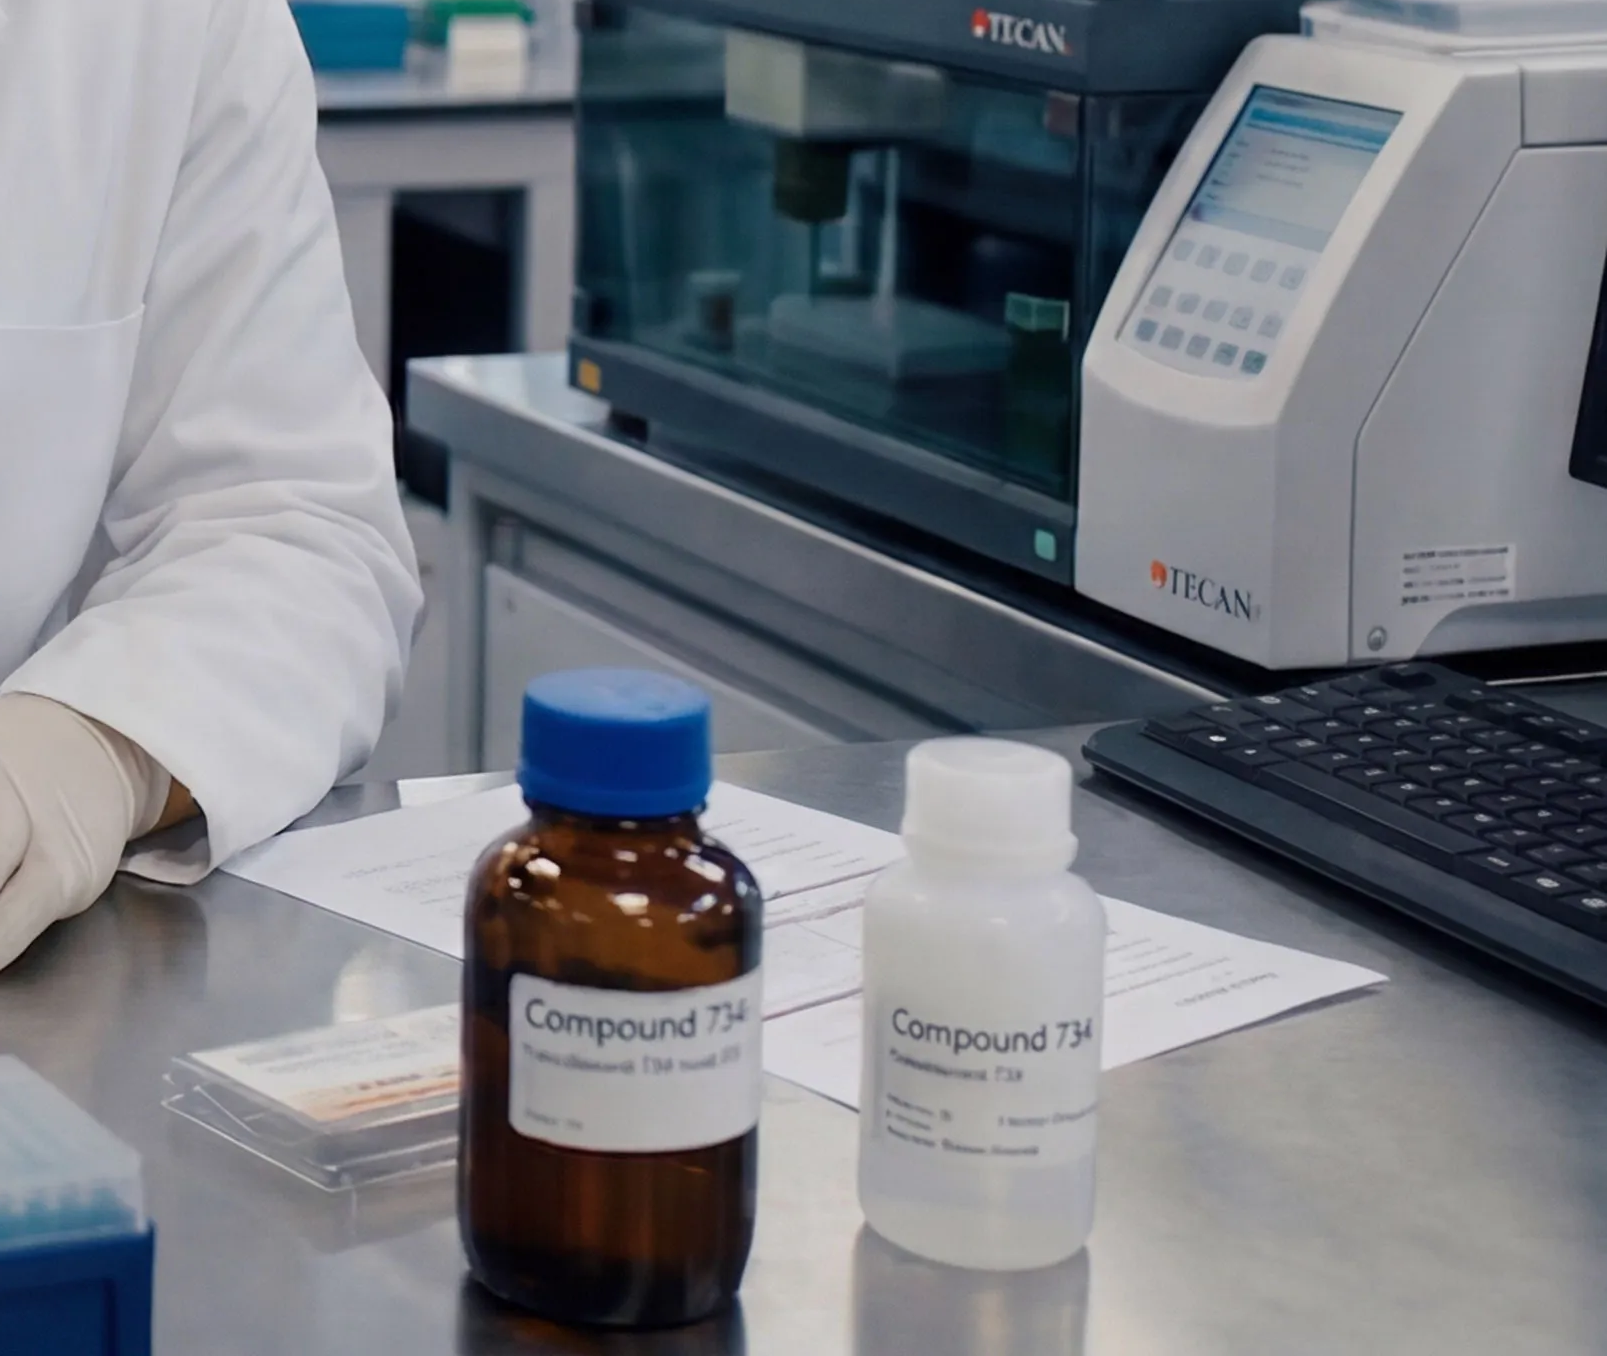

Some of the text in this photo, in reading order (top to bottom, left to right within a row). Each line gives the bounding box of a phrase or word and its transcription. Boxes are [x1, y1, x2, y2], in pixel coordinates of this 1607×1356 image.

[1170, 566, 1251, 621] TECAN
[524, 998, 697, 1047] Compound
[892, 1007, 1093, 1055] Compound 734
